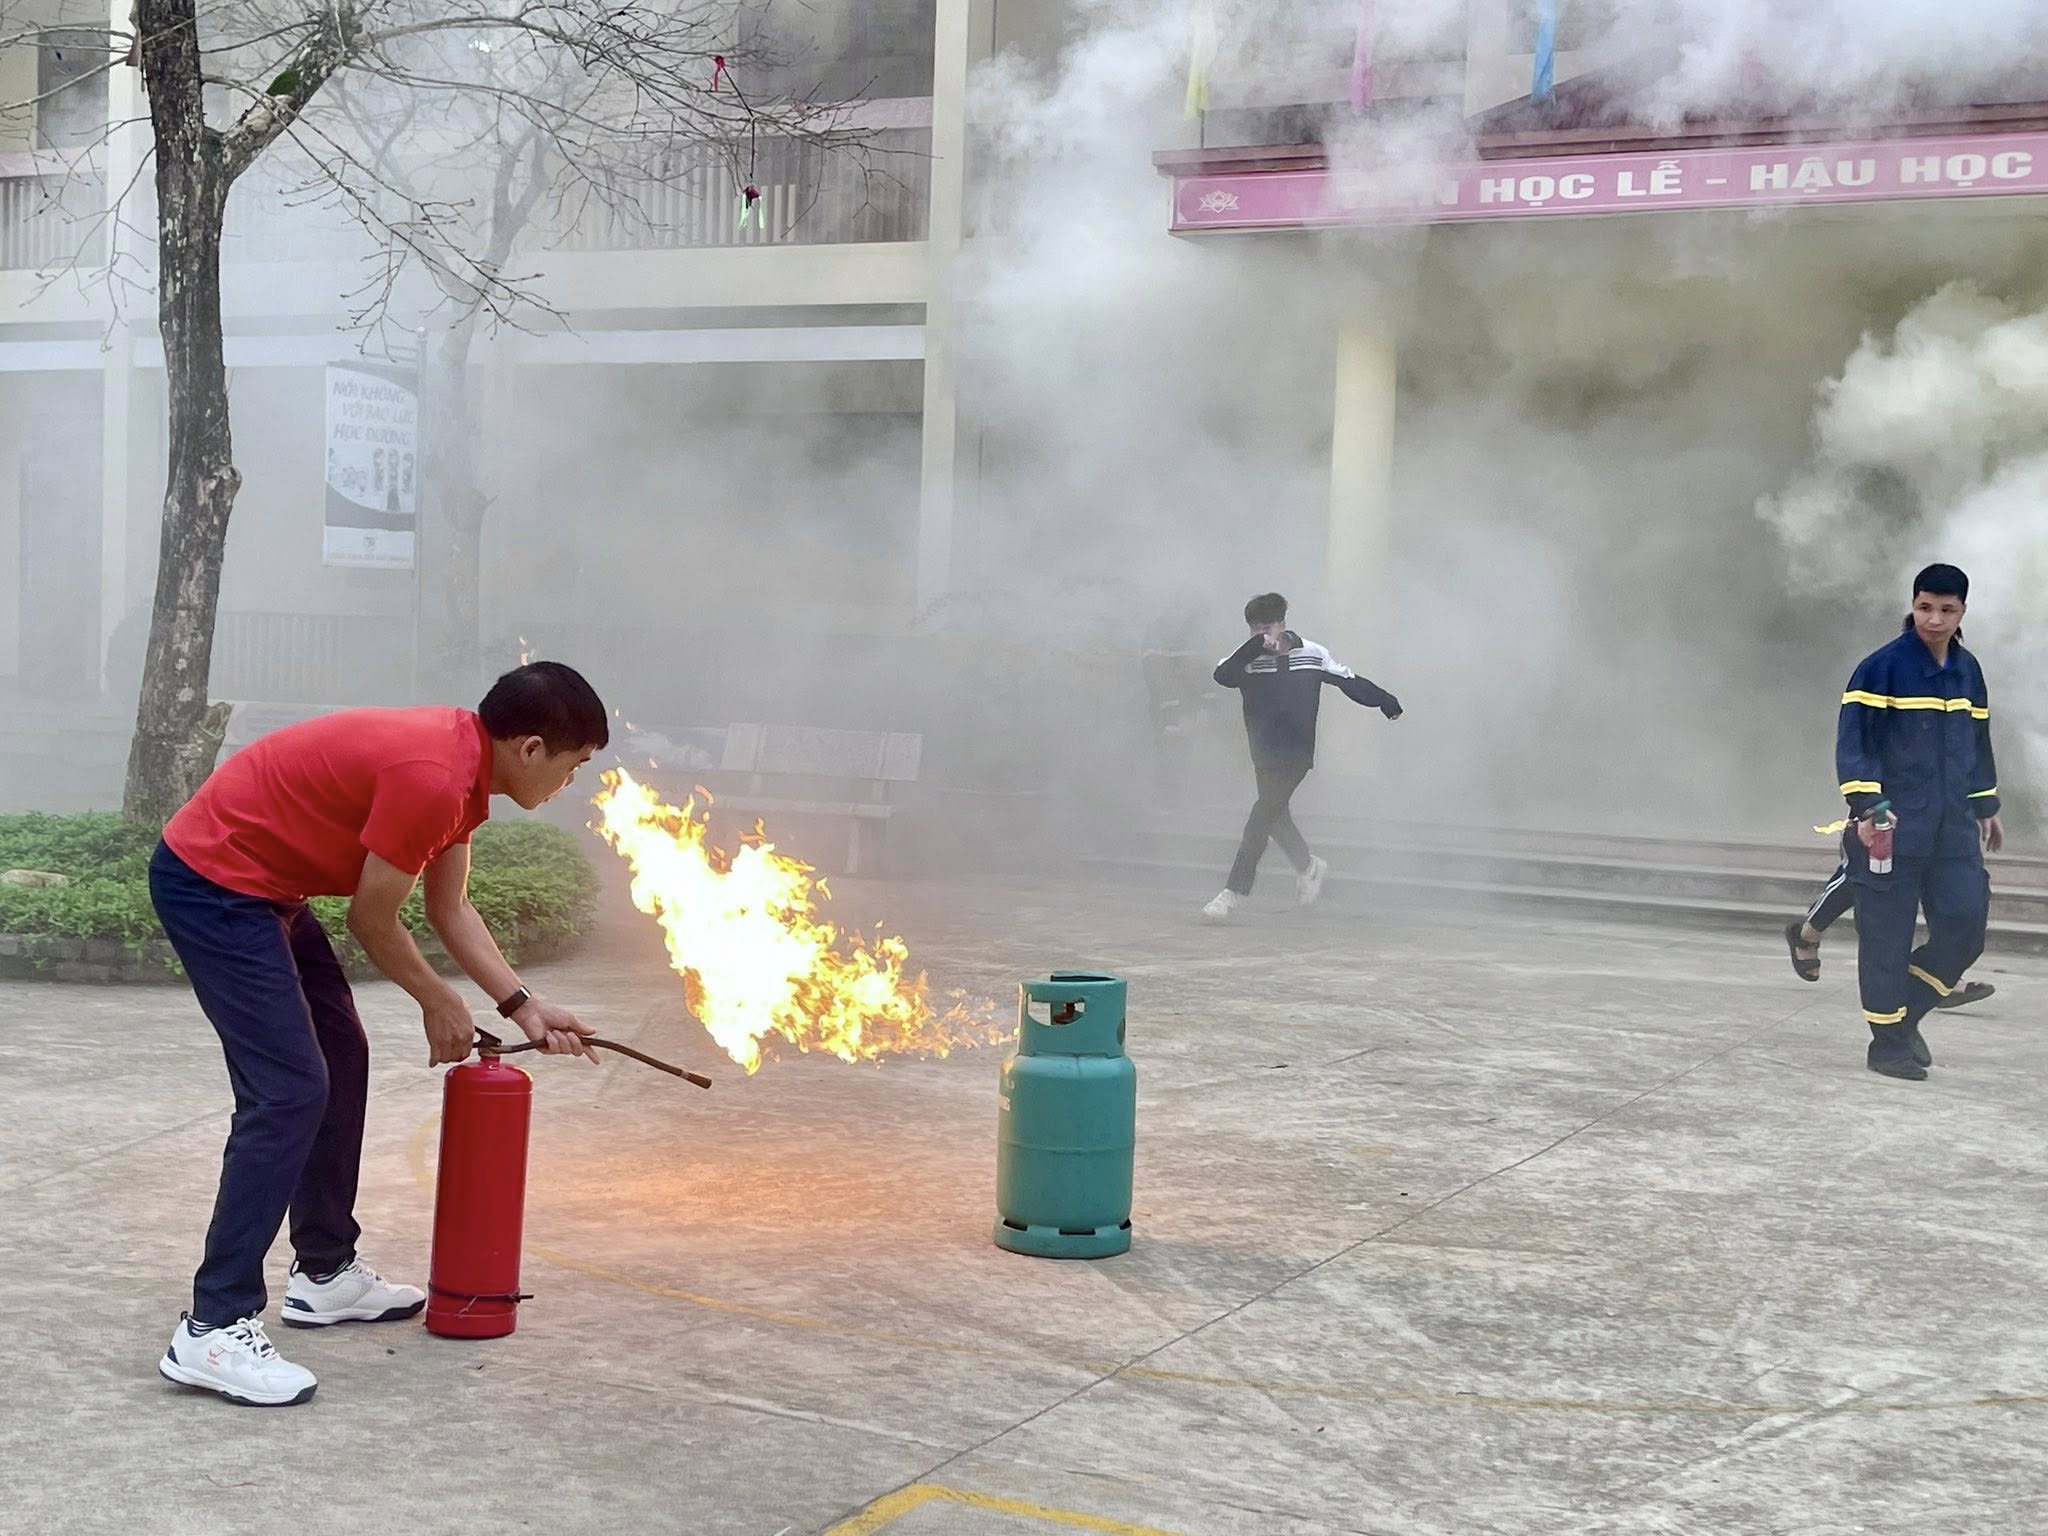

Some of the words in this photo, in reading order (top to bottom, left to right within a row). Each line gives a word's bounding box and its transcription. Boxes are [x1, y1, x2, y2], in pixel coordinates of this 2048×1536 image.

[1479, 173, 1596, 207] HỌC
[1616, 159, 1683, 197] LỄ
[1749, 156, 1877, 194] HẬU
[1900, 151, 2034, 188] HỌC
